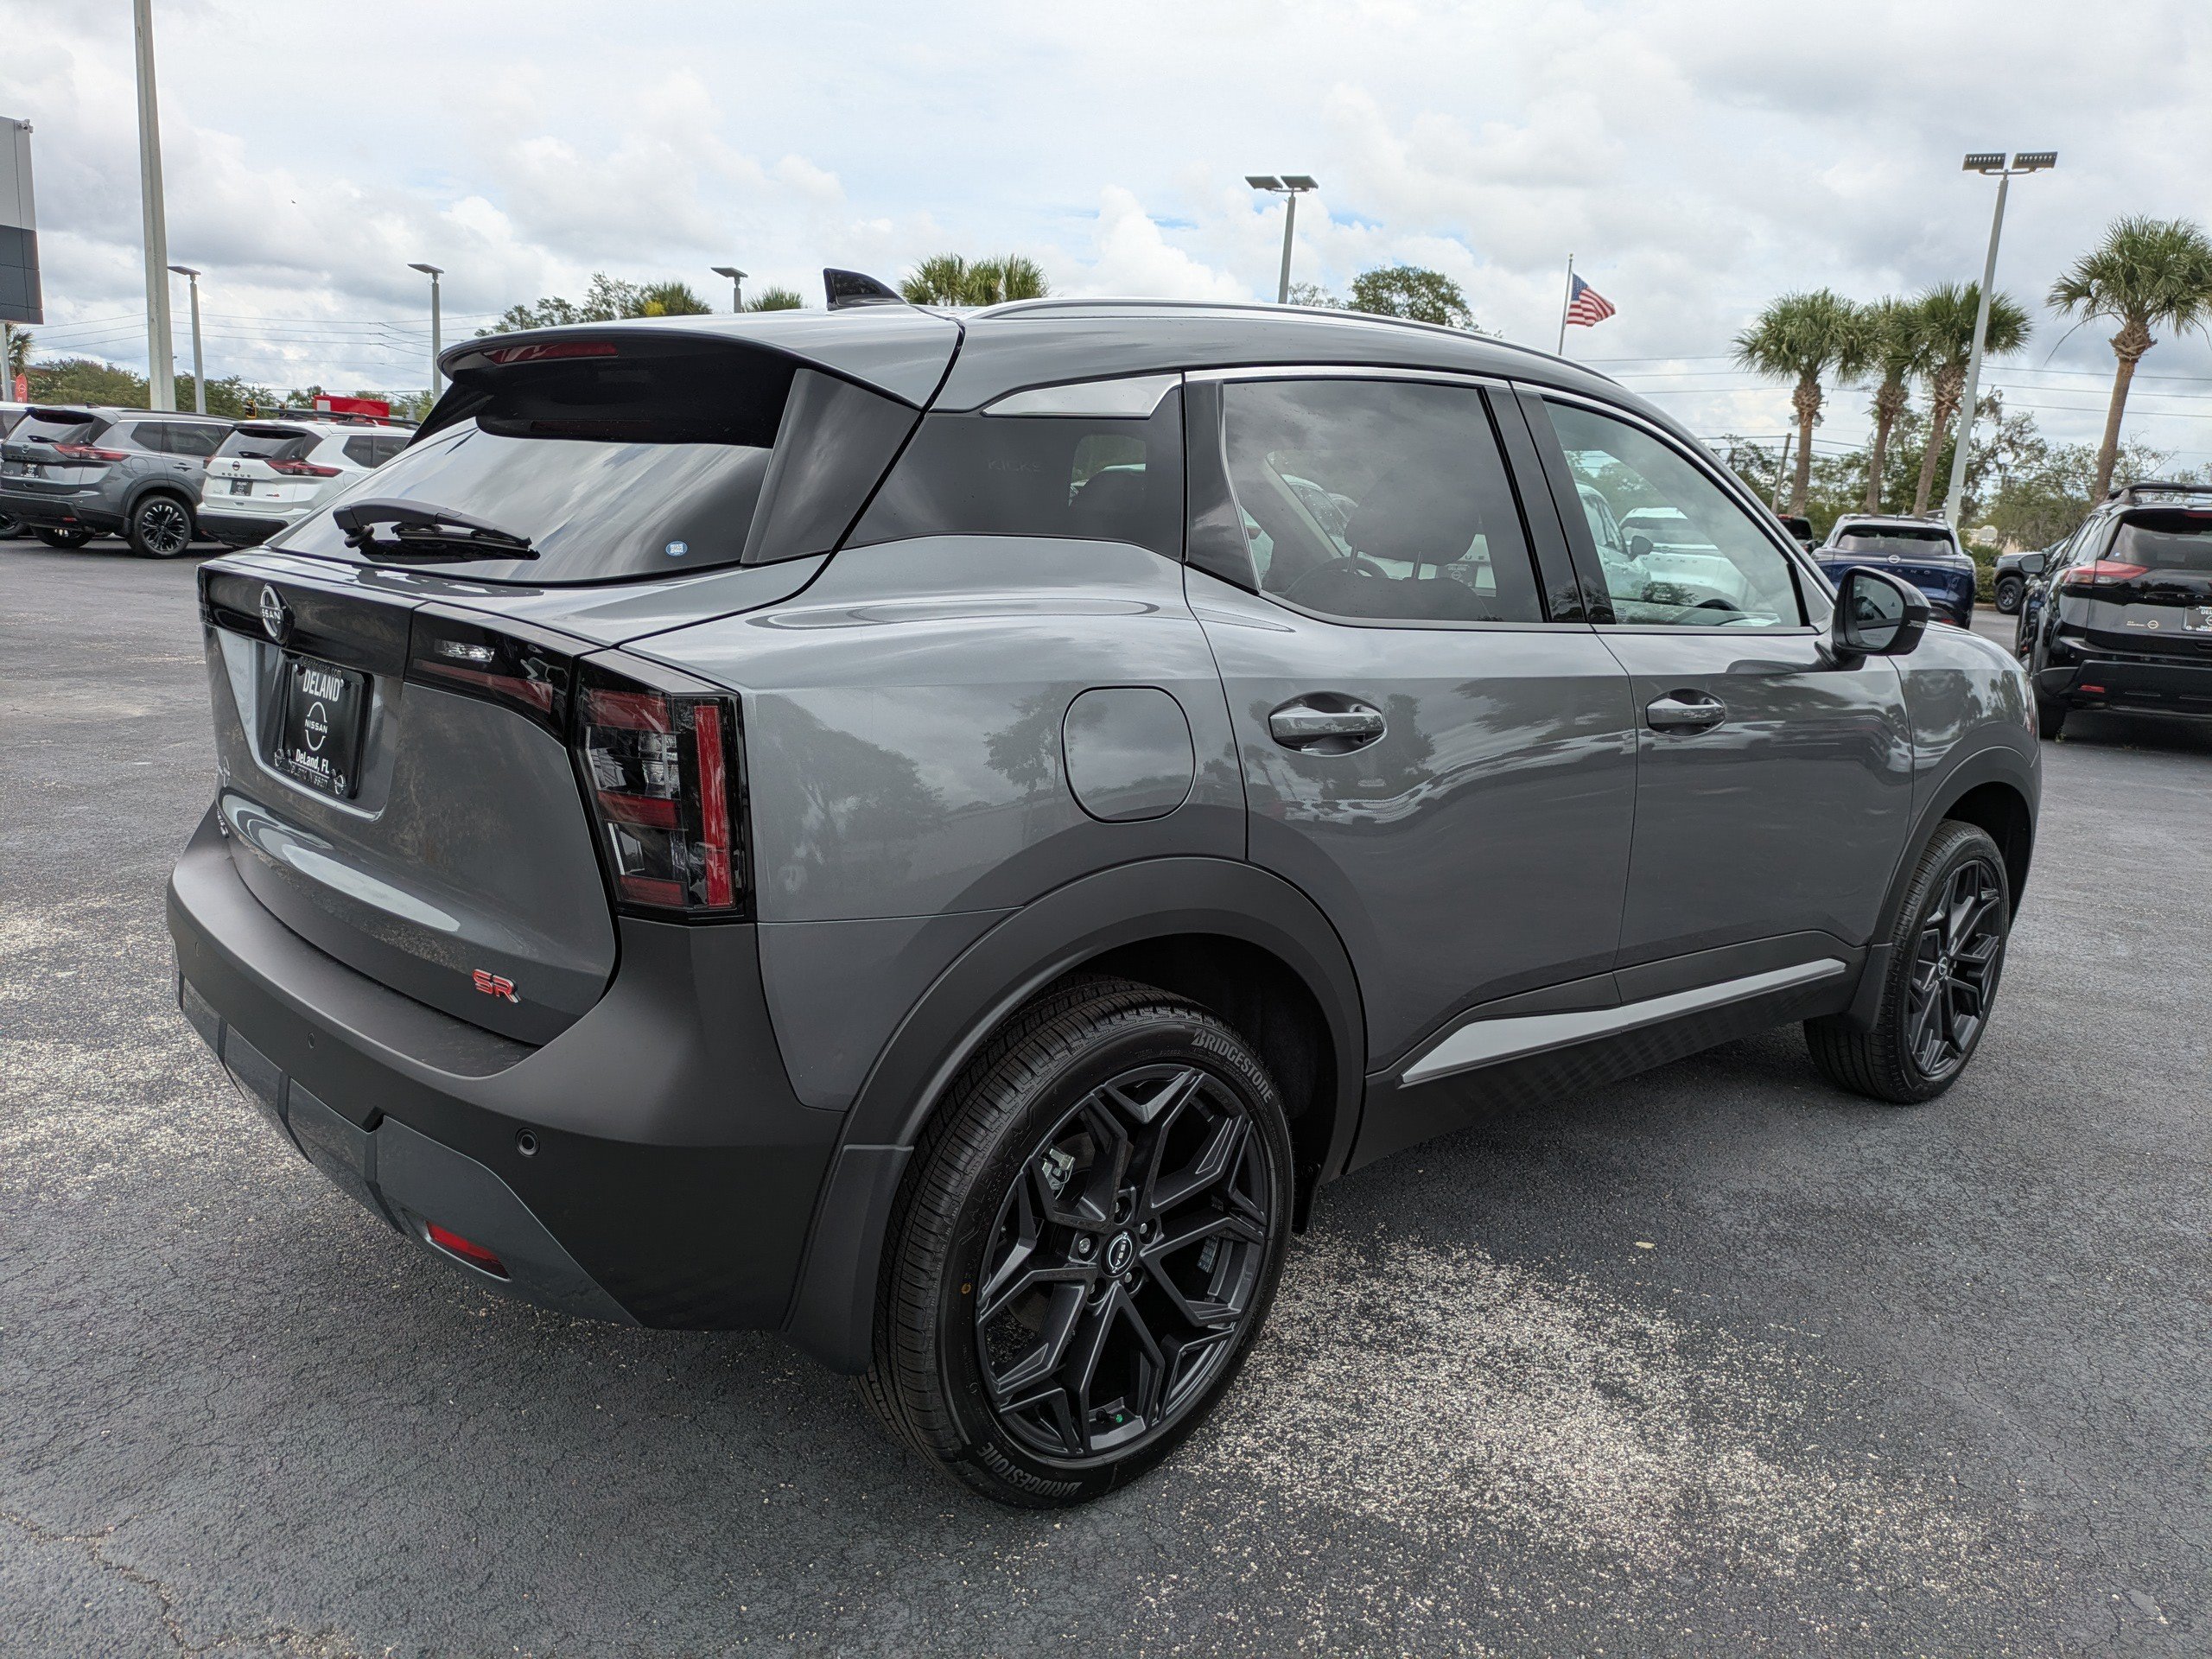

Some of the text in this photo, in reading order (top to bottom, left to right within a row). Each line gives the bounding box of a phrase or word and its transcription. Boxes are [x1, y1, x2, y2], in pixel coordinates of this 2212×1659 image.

[302, 669, 340, 702] DELAND
[305, 719, 328, 734] NISSAN
[296, 748, 330, 774] DeLand, FL
[473, 969, 519, 1003] SR
[1192, 1027, 1274, 1103] BRIDGESTONE
[1111, 1231, 1128, 1274] NISSAN
[976, 1441, 1083, 1497] BRIDGESTONE
